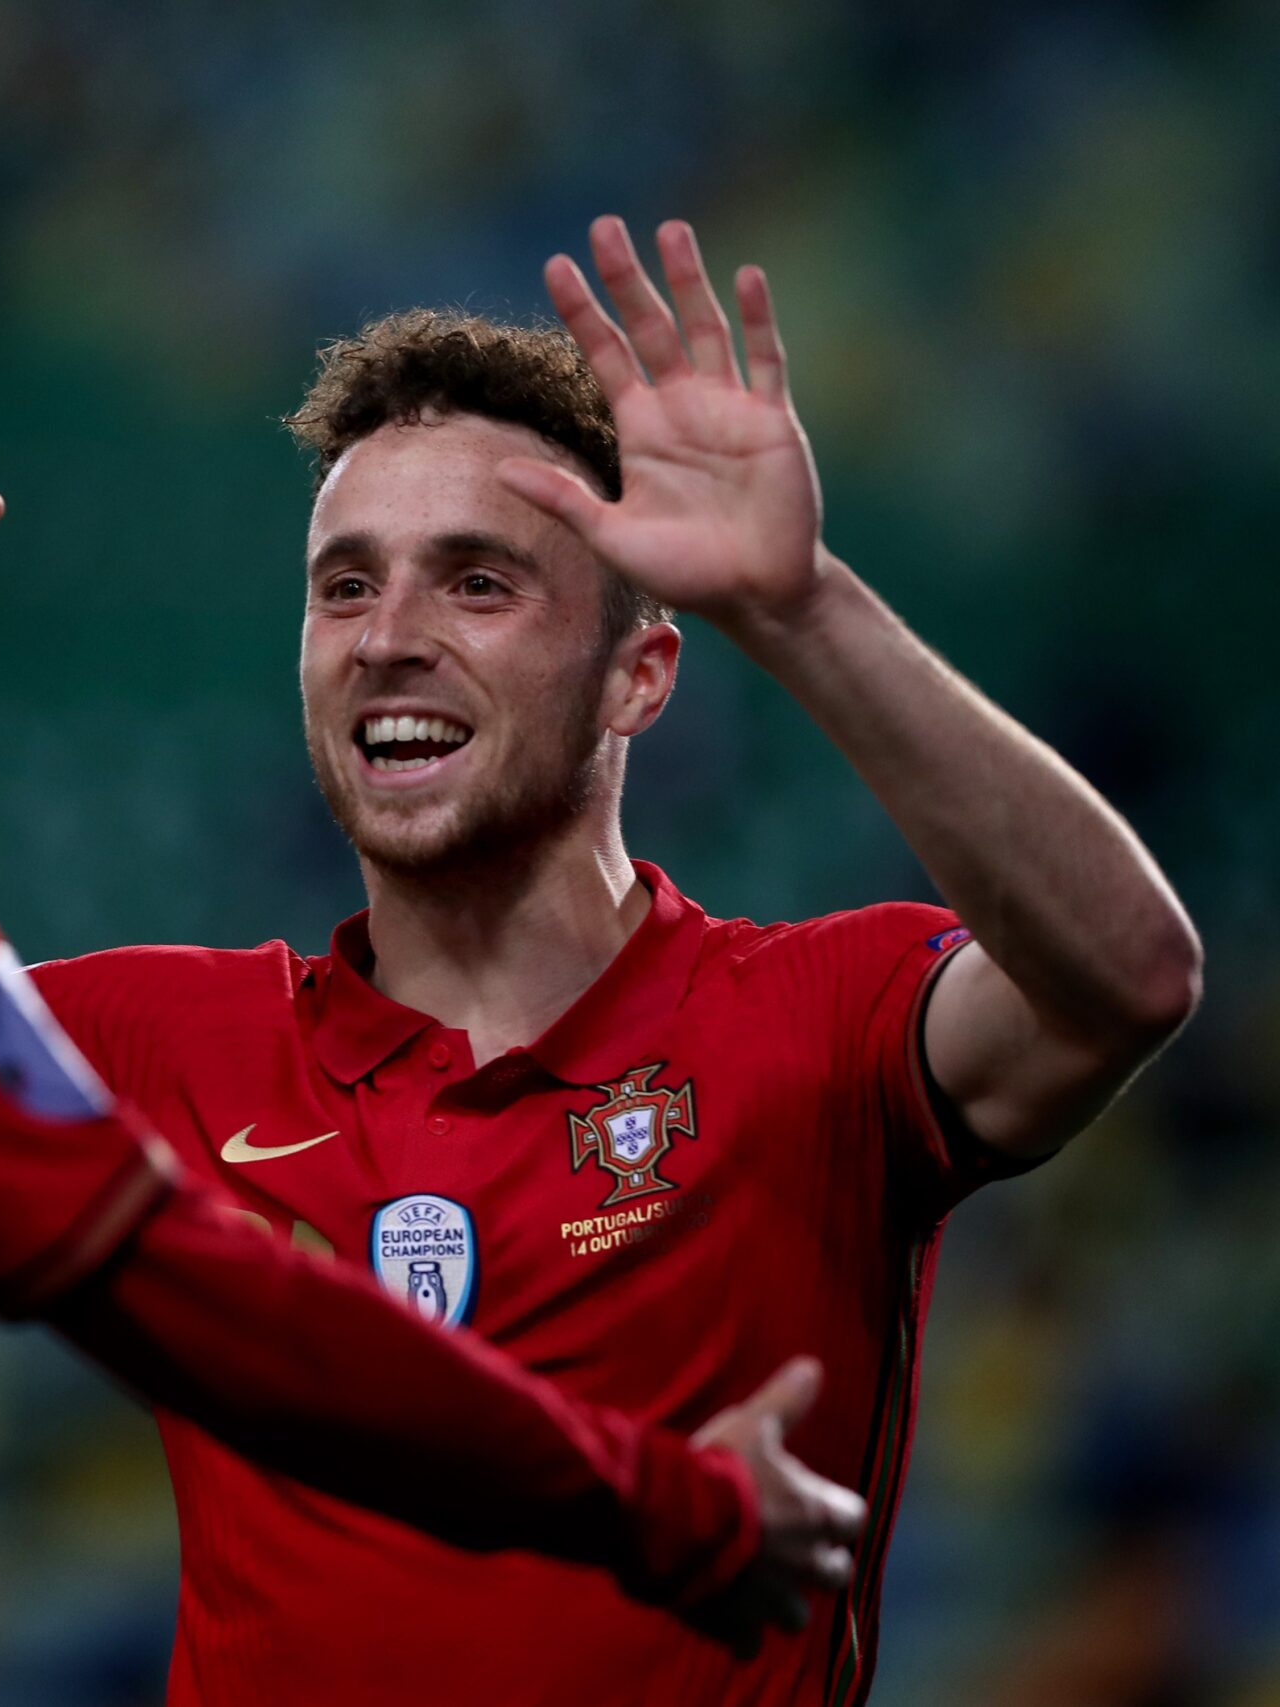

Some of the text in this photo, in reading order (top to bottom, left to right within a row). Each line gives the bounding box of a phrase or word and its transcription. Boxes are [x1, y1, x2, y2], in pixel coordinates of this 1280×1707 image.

[400, 1206, 443, 1224] UEFA
[381, 1228, 464, 1244] EUROPEAN
[381, 1243, 466, 1258] CHAMPIONS
[570, 1240, 587, 1258] 14
